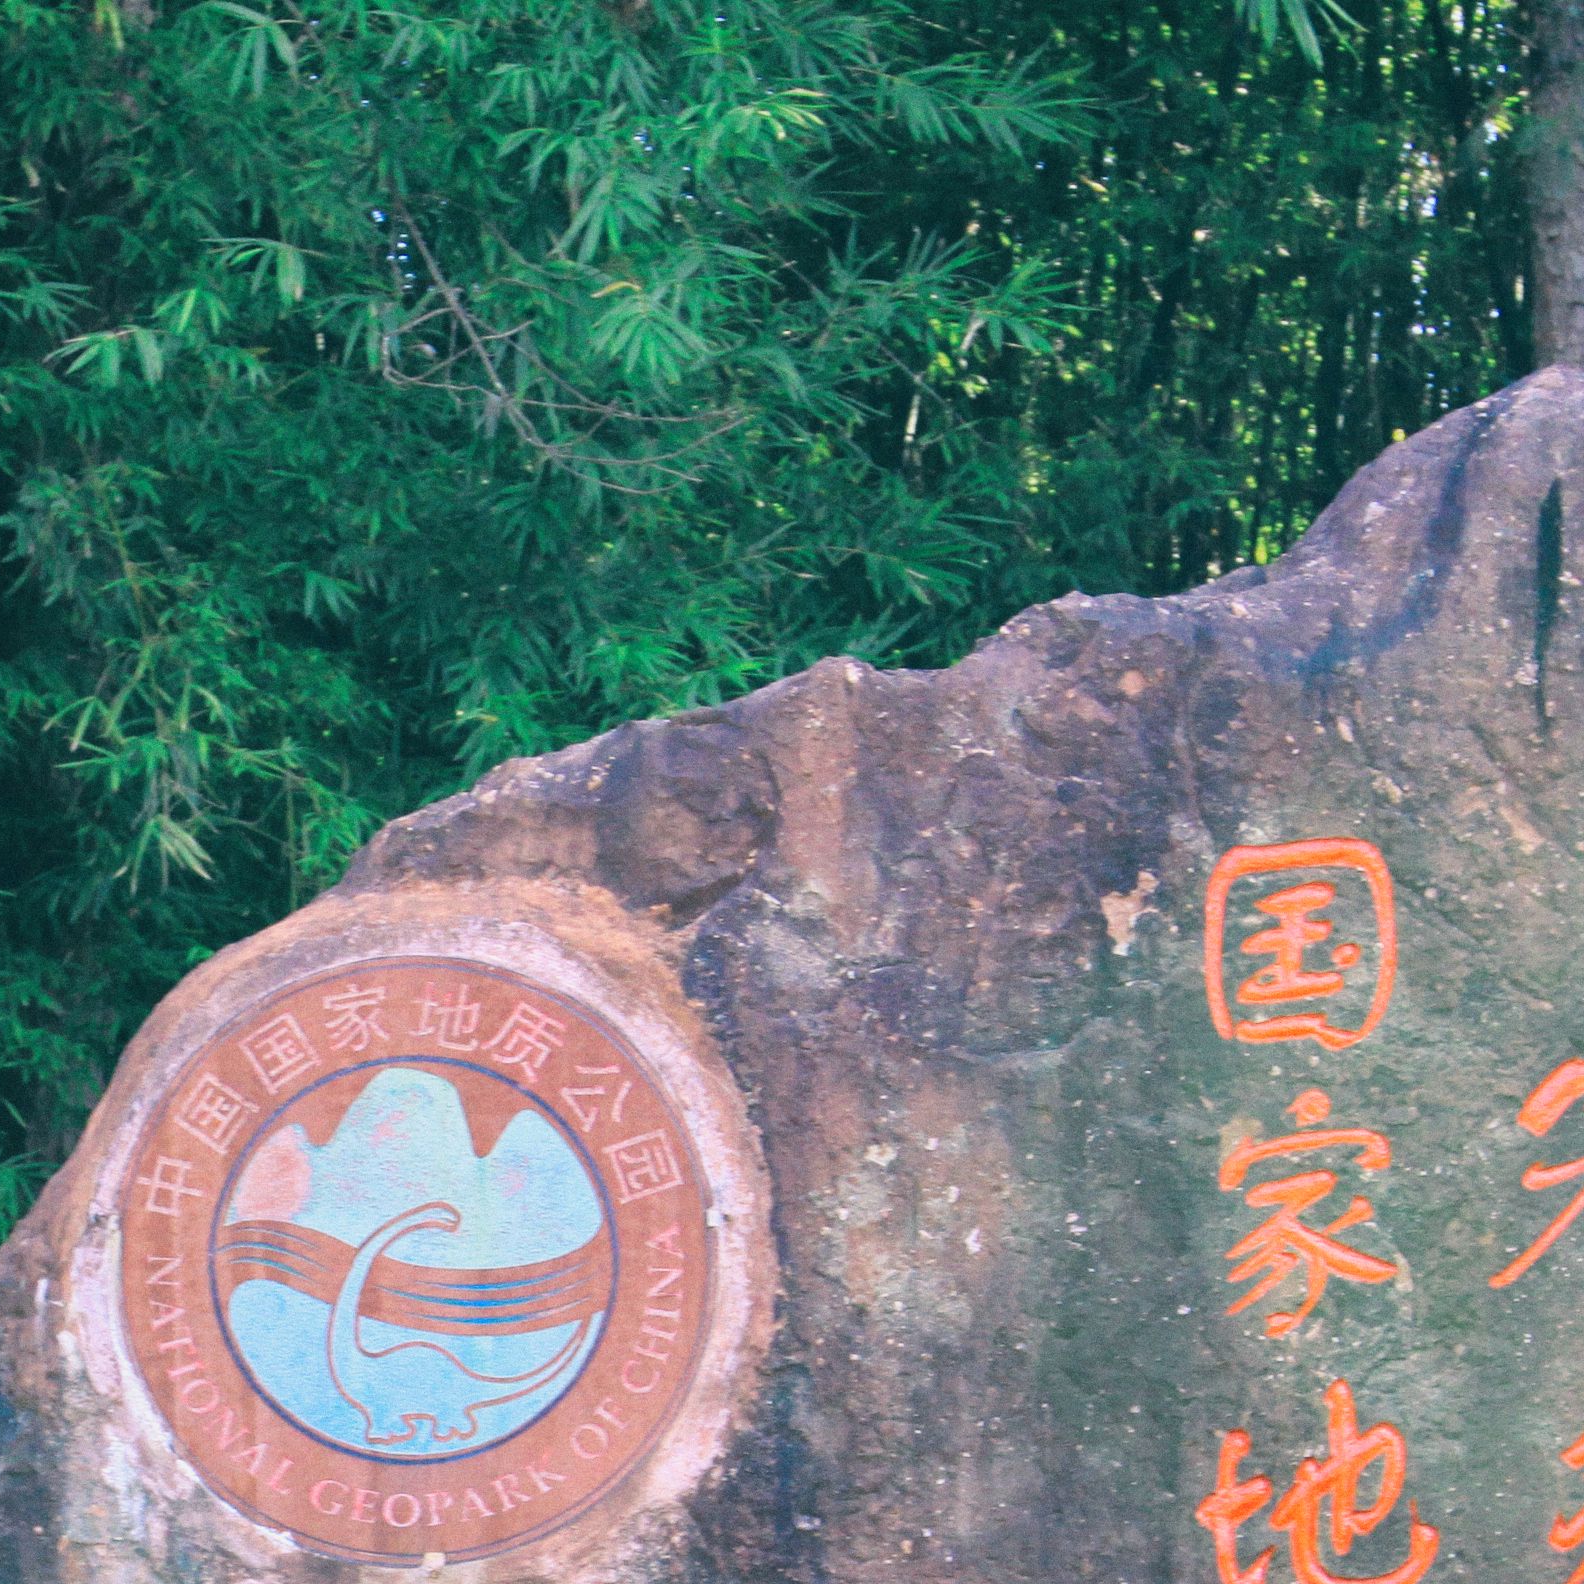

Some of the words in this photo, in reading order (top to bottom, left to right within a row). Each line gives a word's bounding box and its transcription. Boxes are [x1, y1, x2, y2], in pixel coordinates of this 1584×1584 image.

[136, 981, 683, 1217] 中国国家地质公园
[146, 1253, 295, 1497] NATIONAL
[308, 1450, 569, 1529] GEOPARK
[569, 1396, 630, 1461] OF
[620, 1222, 687, 1398] CHINA
